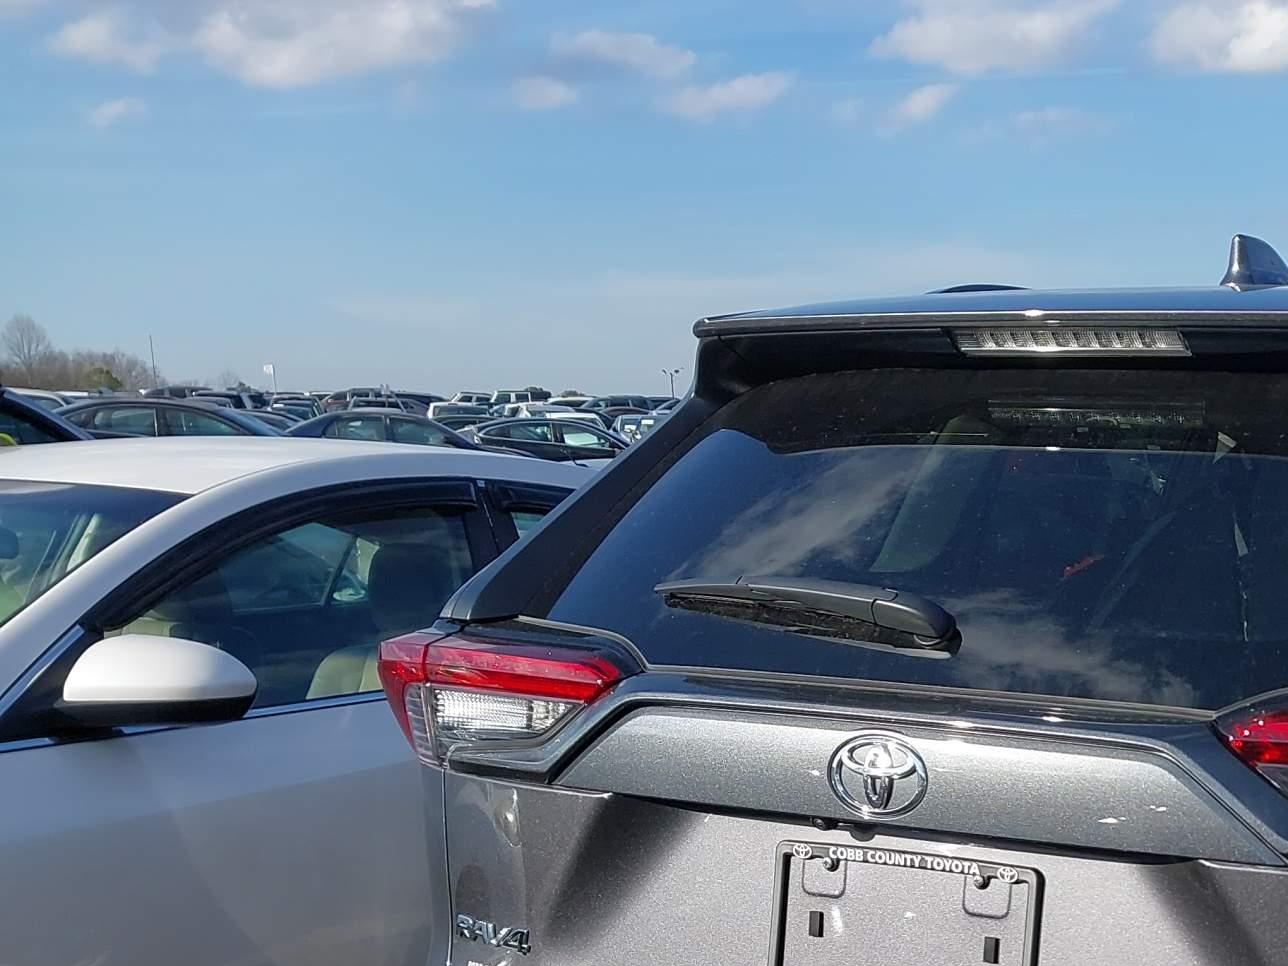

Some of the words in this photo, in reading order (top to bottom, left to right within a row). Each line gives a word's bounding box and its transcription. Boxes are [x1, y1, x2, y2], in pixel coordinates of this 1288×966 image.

[829, 847, 864, 861] COBB
[867, 851, 921, 867] COUNTY
[923, 856, 980, 875] TOYOTA
[456, 913, 531, 955] RAV4
